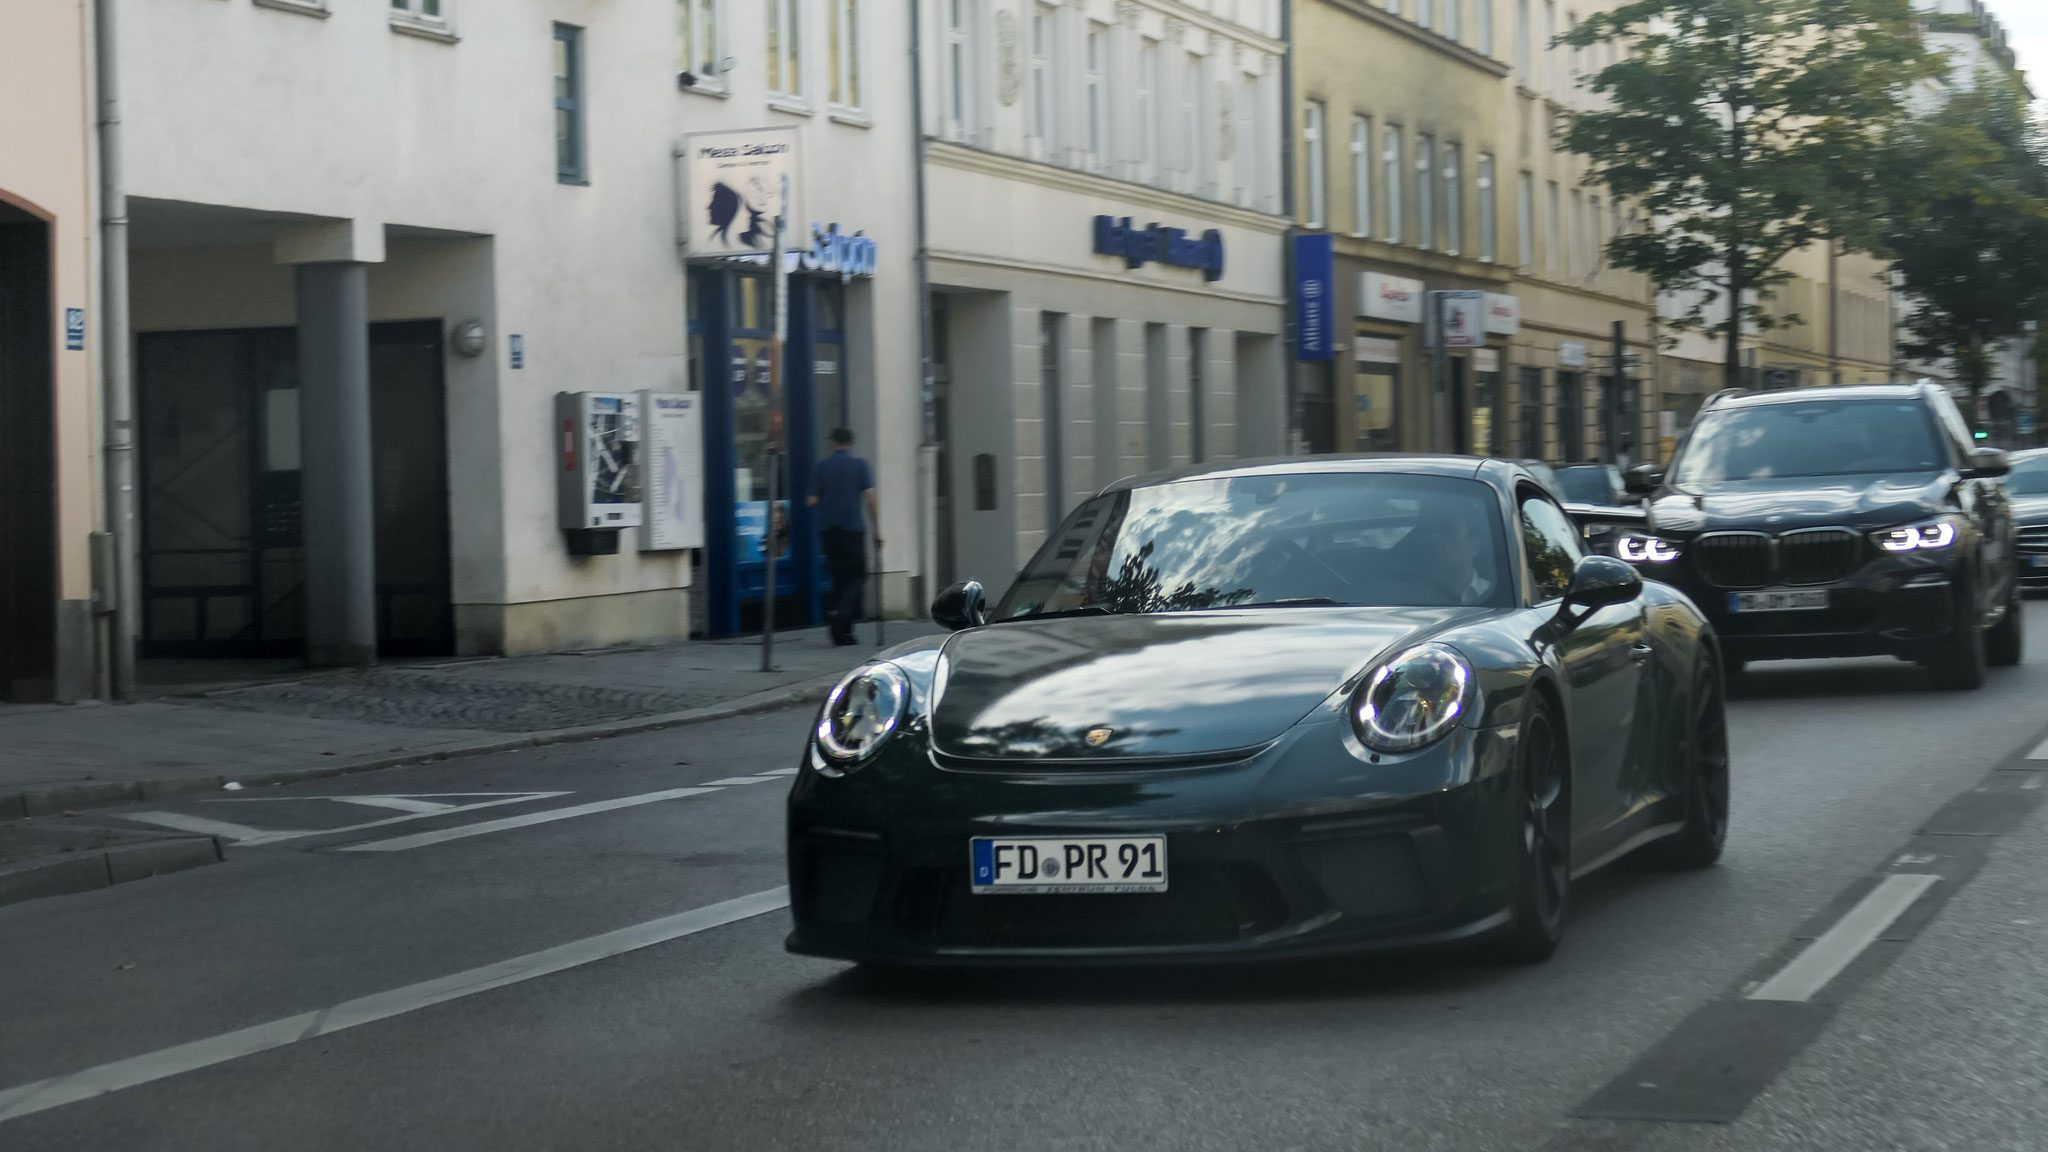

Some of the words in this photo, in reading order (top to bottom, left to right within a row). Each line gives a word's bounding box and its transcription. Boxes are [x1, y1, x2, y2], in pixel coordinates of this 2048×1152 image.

[1303, 301, 1321, 351] Allianz
[995, 845, 1039, 880] FD
[1063, 844, 1109, 879] PR
[1118, 842, 1162, 879] 91
